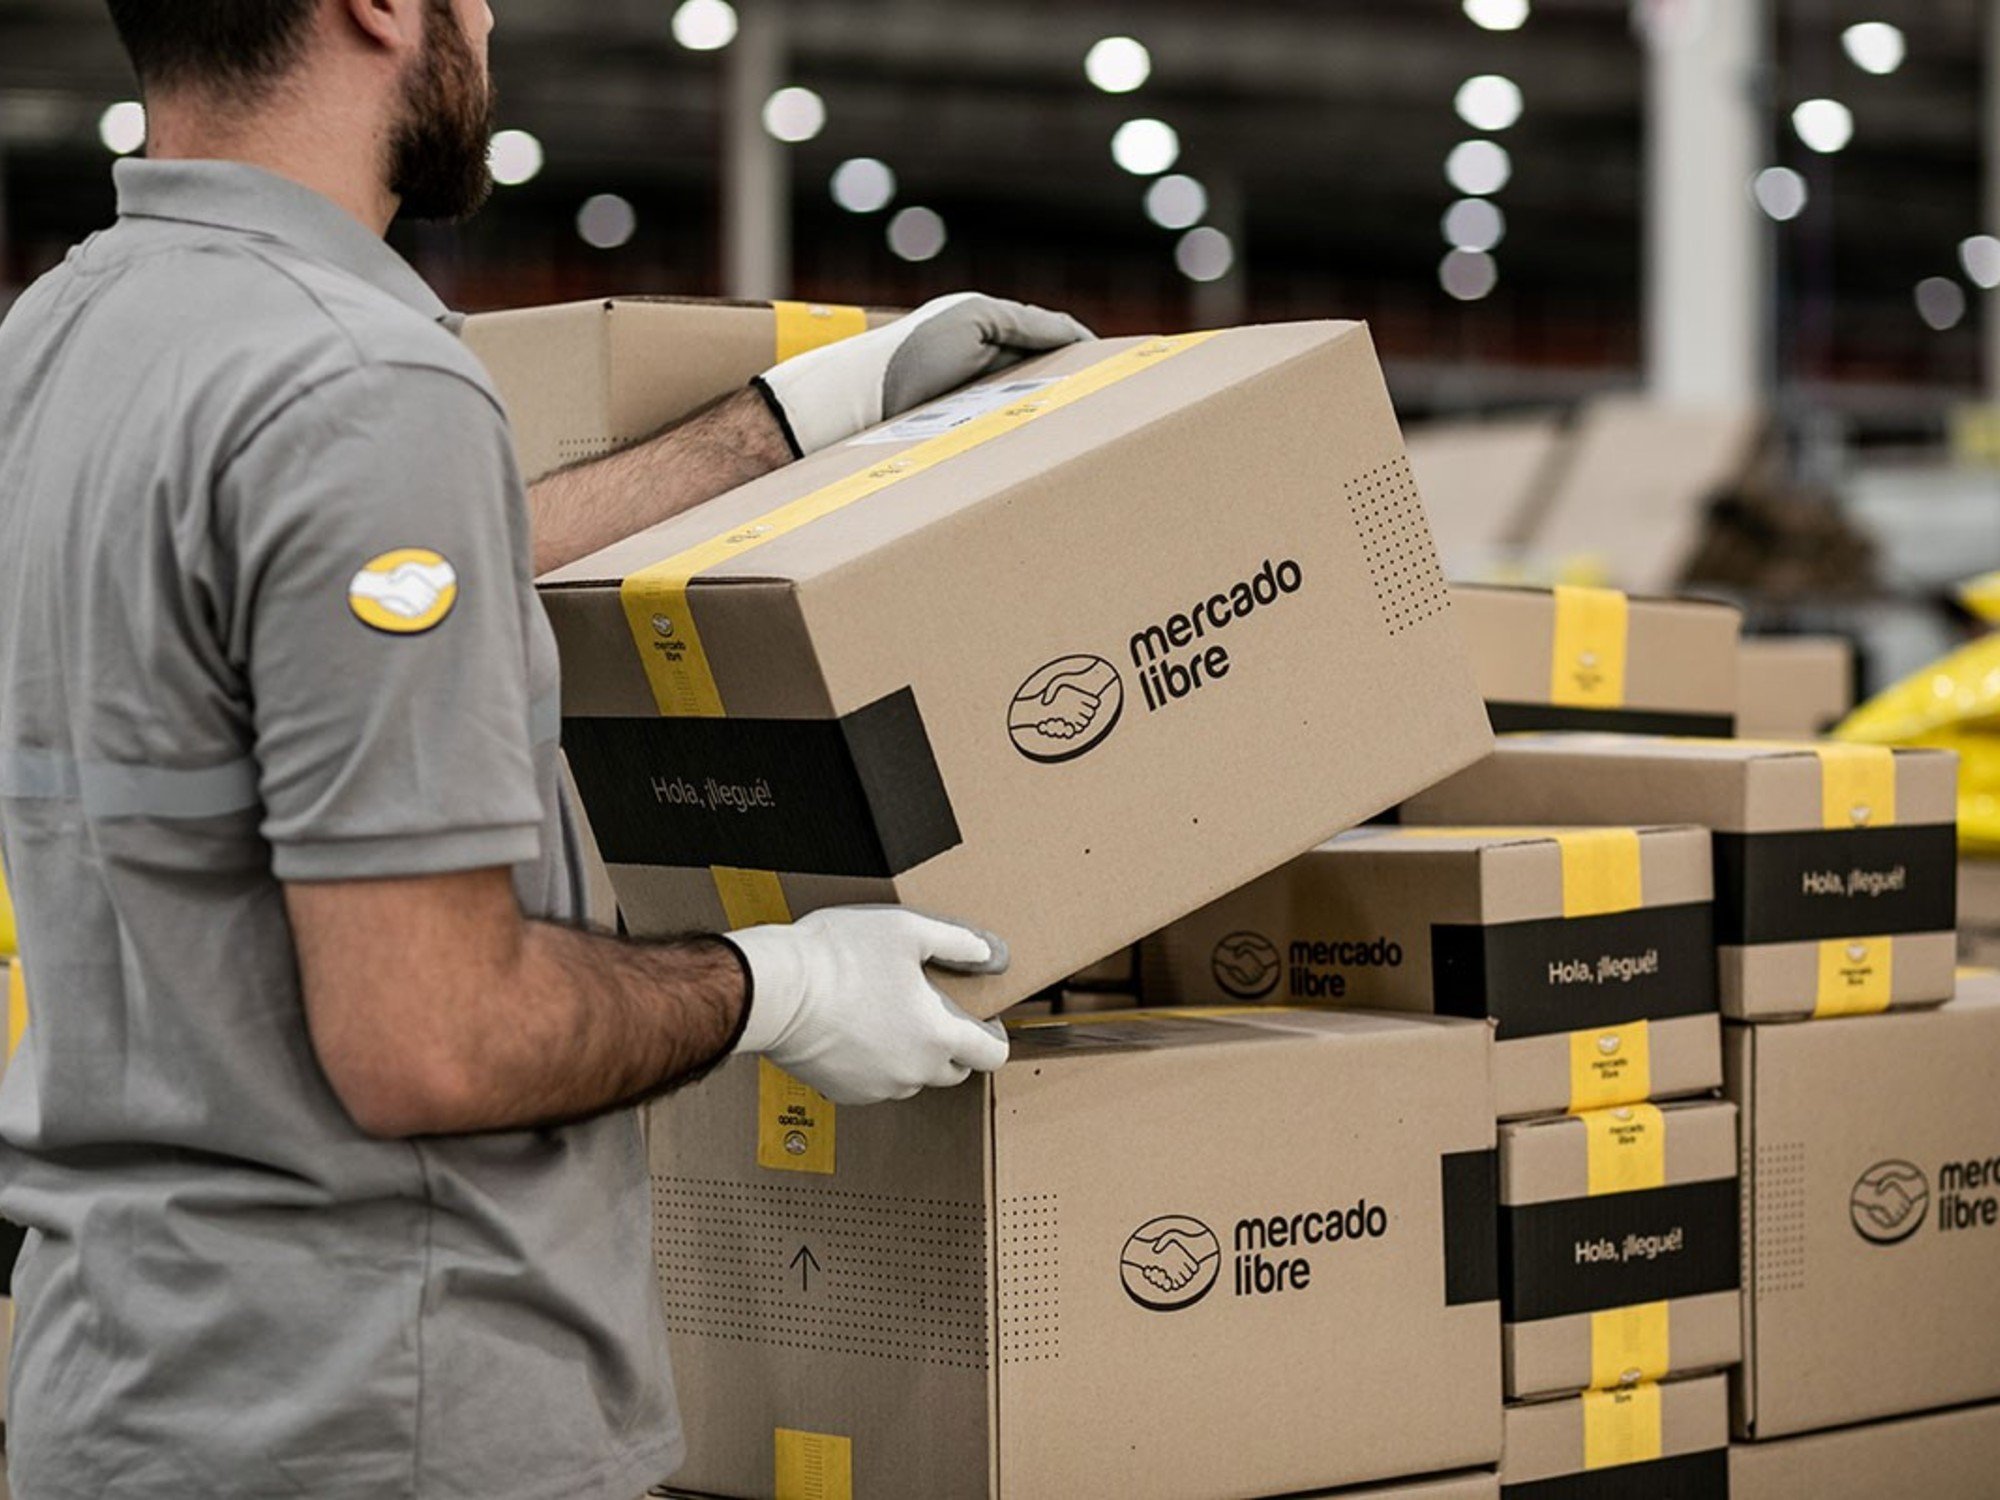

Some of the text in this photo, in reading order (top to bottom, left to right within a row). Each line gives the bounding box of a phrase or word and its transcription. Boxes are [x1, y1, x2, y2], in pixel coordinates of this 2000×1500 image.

[1129, 558, 1302, 668] mercado
[1138, 644, 1230, 712] libre
[650, 777, 776, 813] Hola, ¡llegué!
[1803, 870, 1845, 895] Hola,
[1288, 936, 1403, 967] mercado
[1549, 949, 1659, 985] Hola, ¡llegué!
[1289, 967, 1346, 998] libre
[1234, 1198, 1388, 1252] mercado
[1939, 1194, 1998, 1232] libre
[1575, 1227, 1683, 1264] Hola, ¡llegué!
[1235, 1253, 1310, 1296] libre
